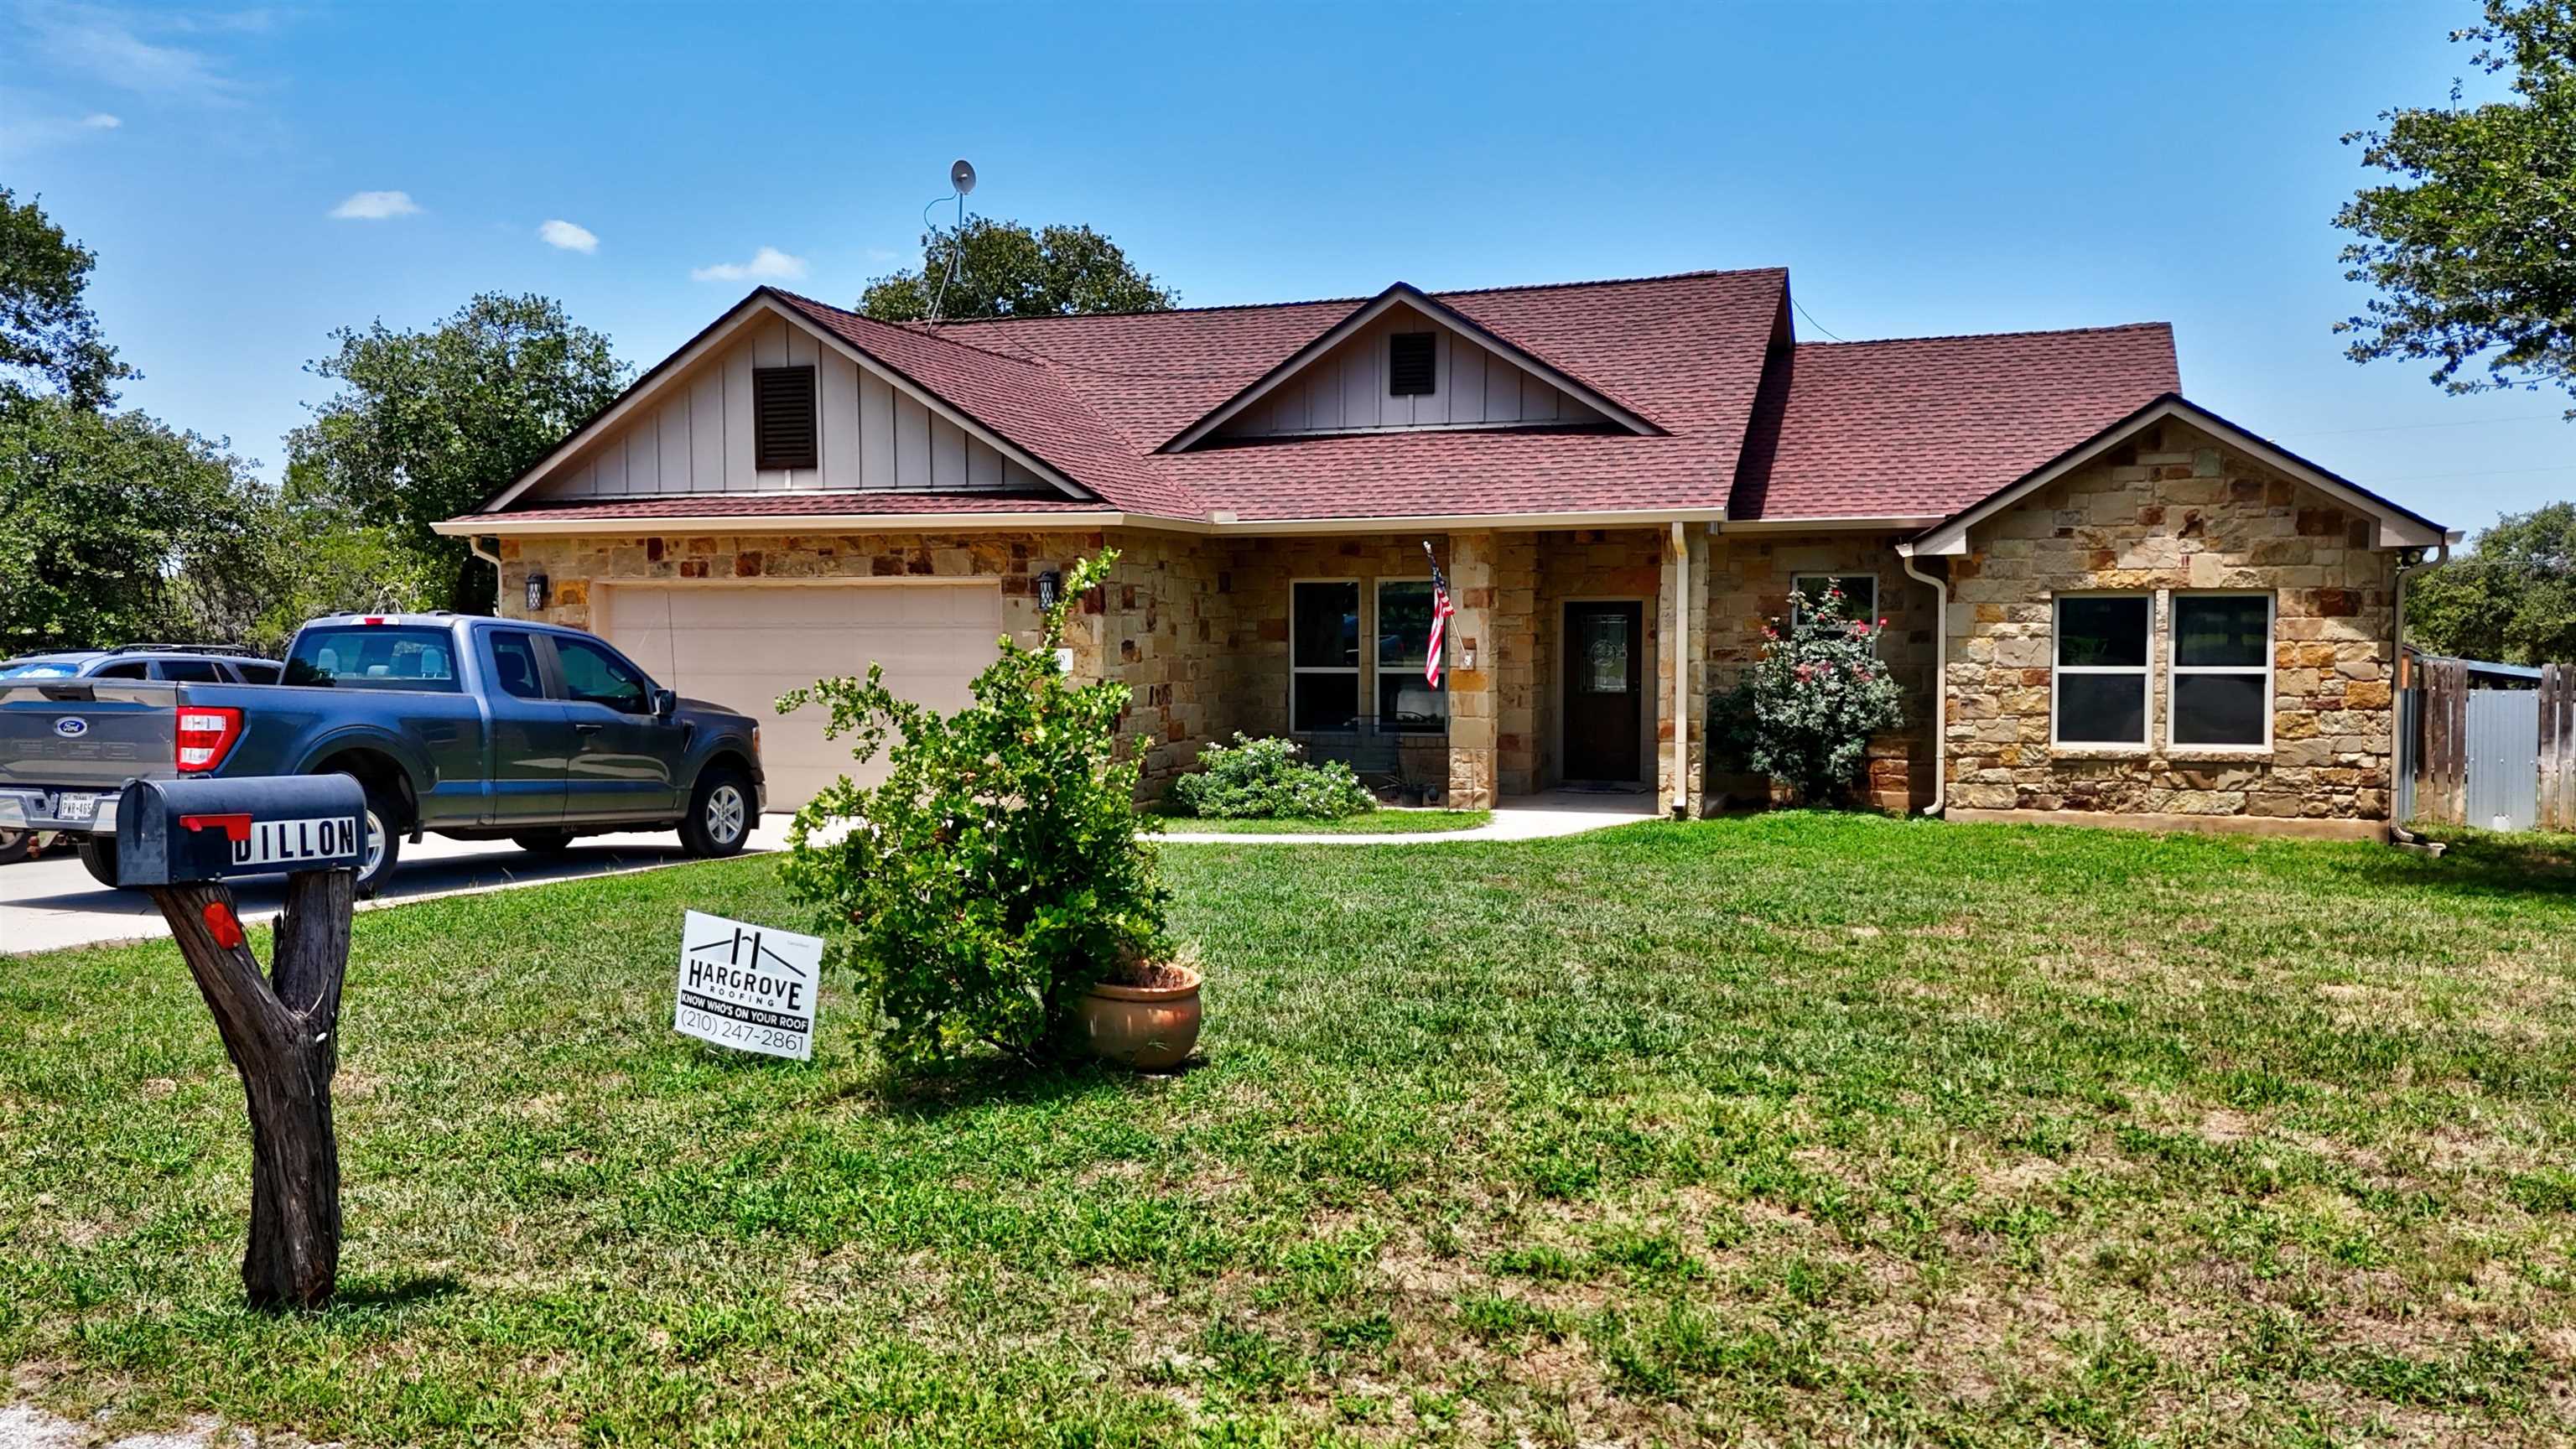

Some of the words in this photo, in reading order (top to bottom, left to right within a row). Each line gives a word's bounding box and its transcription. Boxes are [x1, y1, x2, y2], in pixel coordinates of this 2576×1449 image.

[236, 819, 354, 862] DILLON
[688, 958, 802, 1010] HARGROVE
[710, 985, 774, 1006] ROOFING
[681, 1009, 718, 1036] (210)
[722, 1021, 803, 1052] 247-2861
[682, 993, 705, 1008] KNOW
[707, 1000, 734, 1015] WHO'S
[735, 1009, 749, 1020] ON
[750, 1011, 777, 1025] YOUR
[780, 1016, 808, 1031] ROOF
